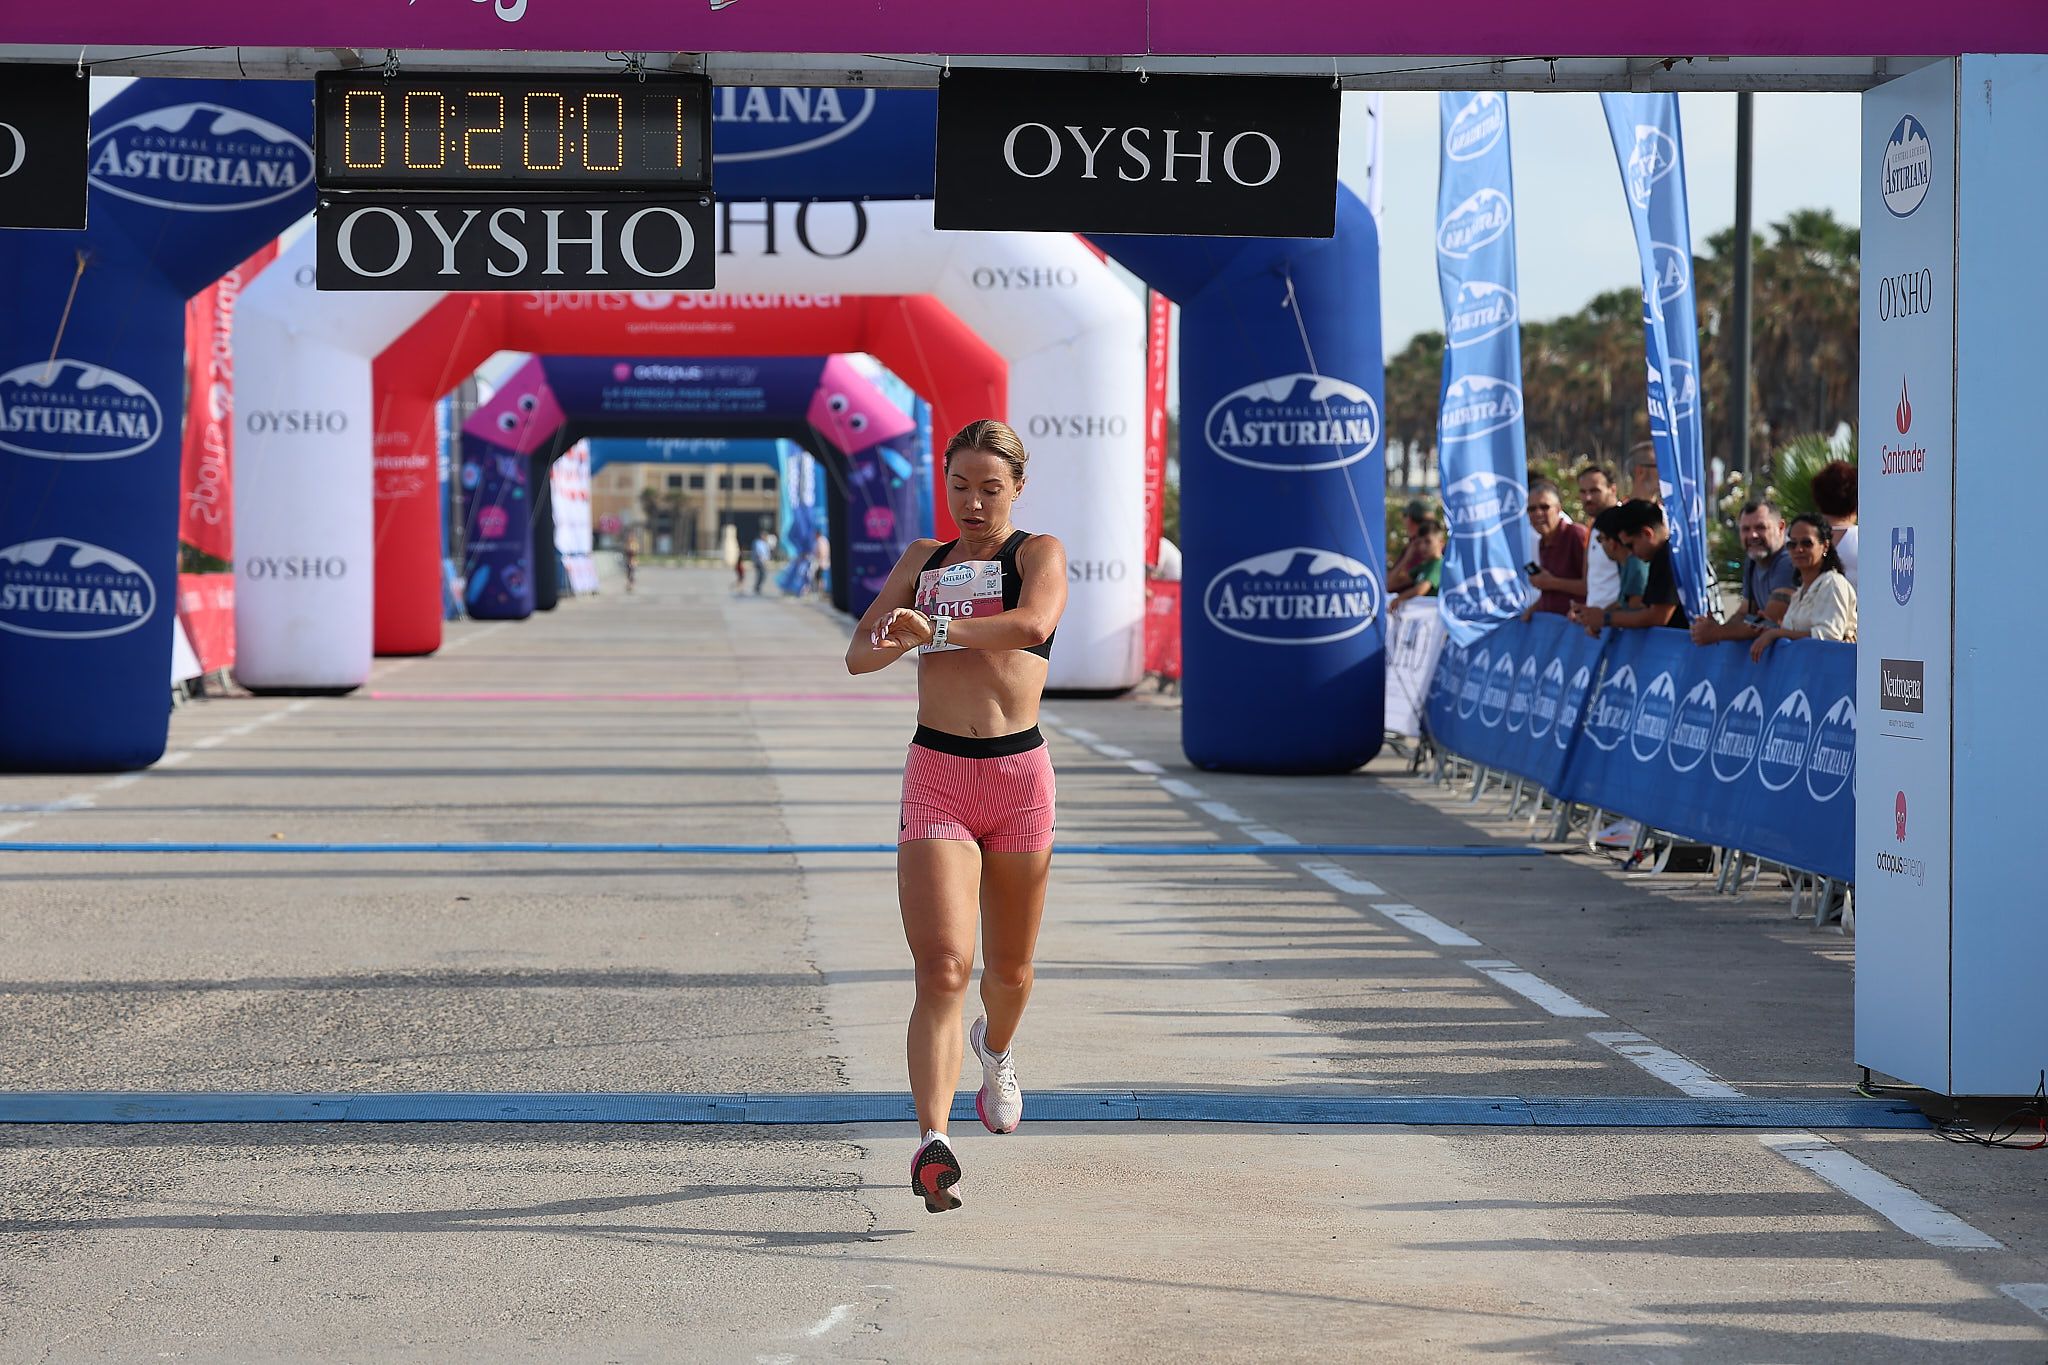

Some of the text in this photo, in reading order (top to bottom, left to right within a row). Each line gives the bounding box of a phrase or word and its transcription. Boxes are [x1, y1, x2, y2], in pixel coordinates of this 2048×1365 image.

[131, 136, 295, 158] CENTRAL LECHERA
[344, 90, 682, 171] 00:20:01
[91, 137, 297, 188] ASTURIANA
[1003, 122, 1281, 187] OYSHO
[1885, 158, 1928, 195] ASTURIANA
[337, 206, 695, 277] OYSHO
[973, 266, 1077, 290] OYSHO
[1880, 268, 1932, 321] OYSHO
[11, 391, 75, 405] CENTRAL
[1244, 405, 1309, 417] CENTRAL
[247, 410, 347, 434] OYSHO
[1029, 415, 1126, 437] OYSHO
[1218, 410, 1373, 446] ASTURIANA
[1881, 443, 1926, 476] Santander
[246, 557, 346, 581] OYSHO
[1069, 560, 1126, 582] SHO
[1243, 580, 1308, 591] CENTRAL
[938, 600, 973, 617] 016
[1216, 582, 1373, 620] ASTURIANA
[1883, 670, 1921, 706] Neutrogena
[1760, 724, 1804, 767] ASTURIANA
[1808, 731, 1850, 777] ASTURIANA
